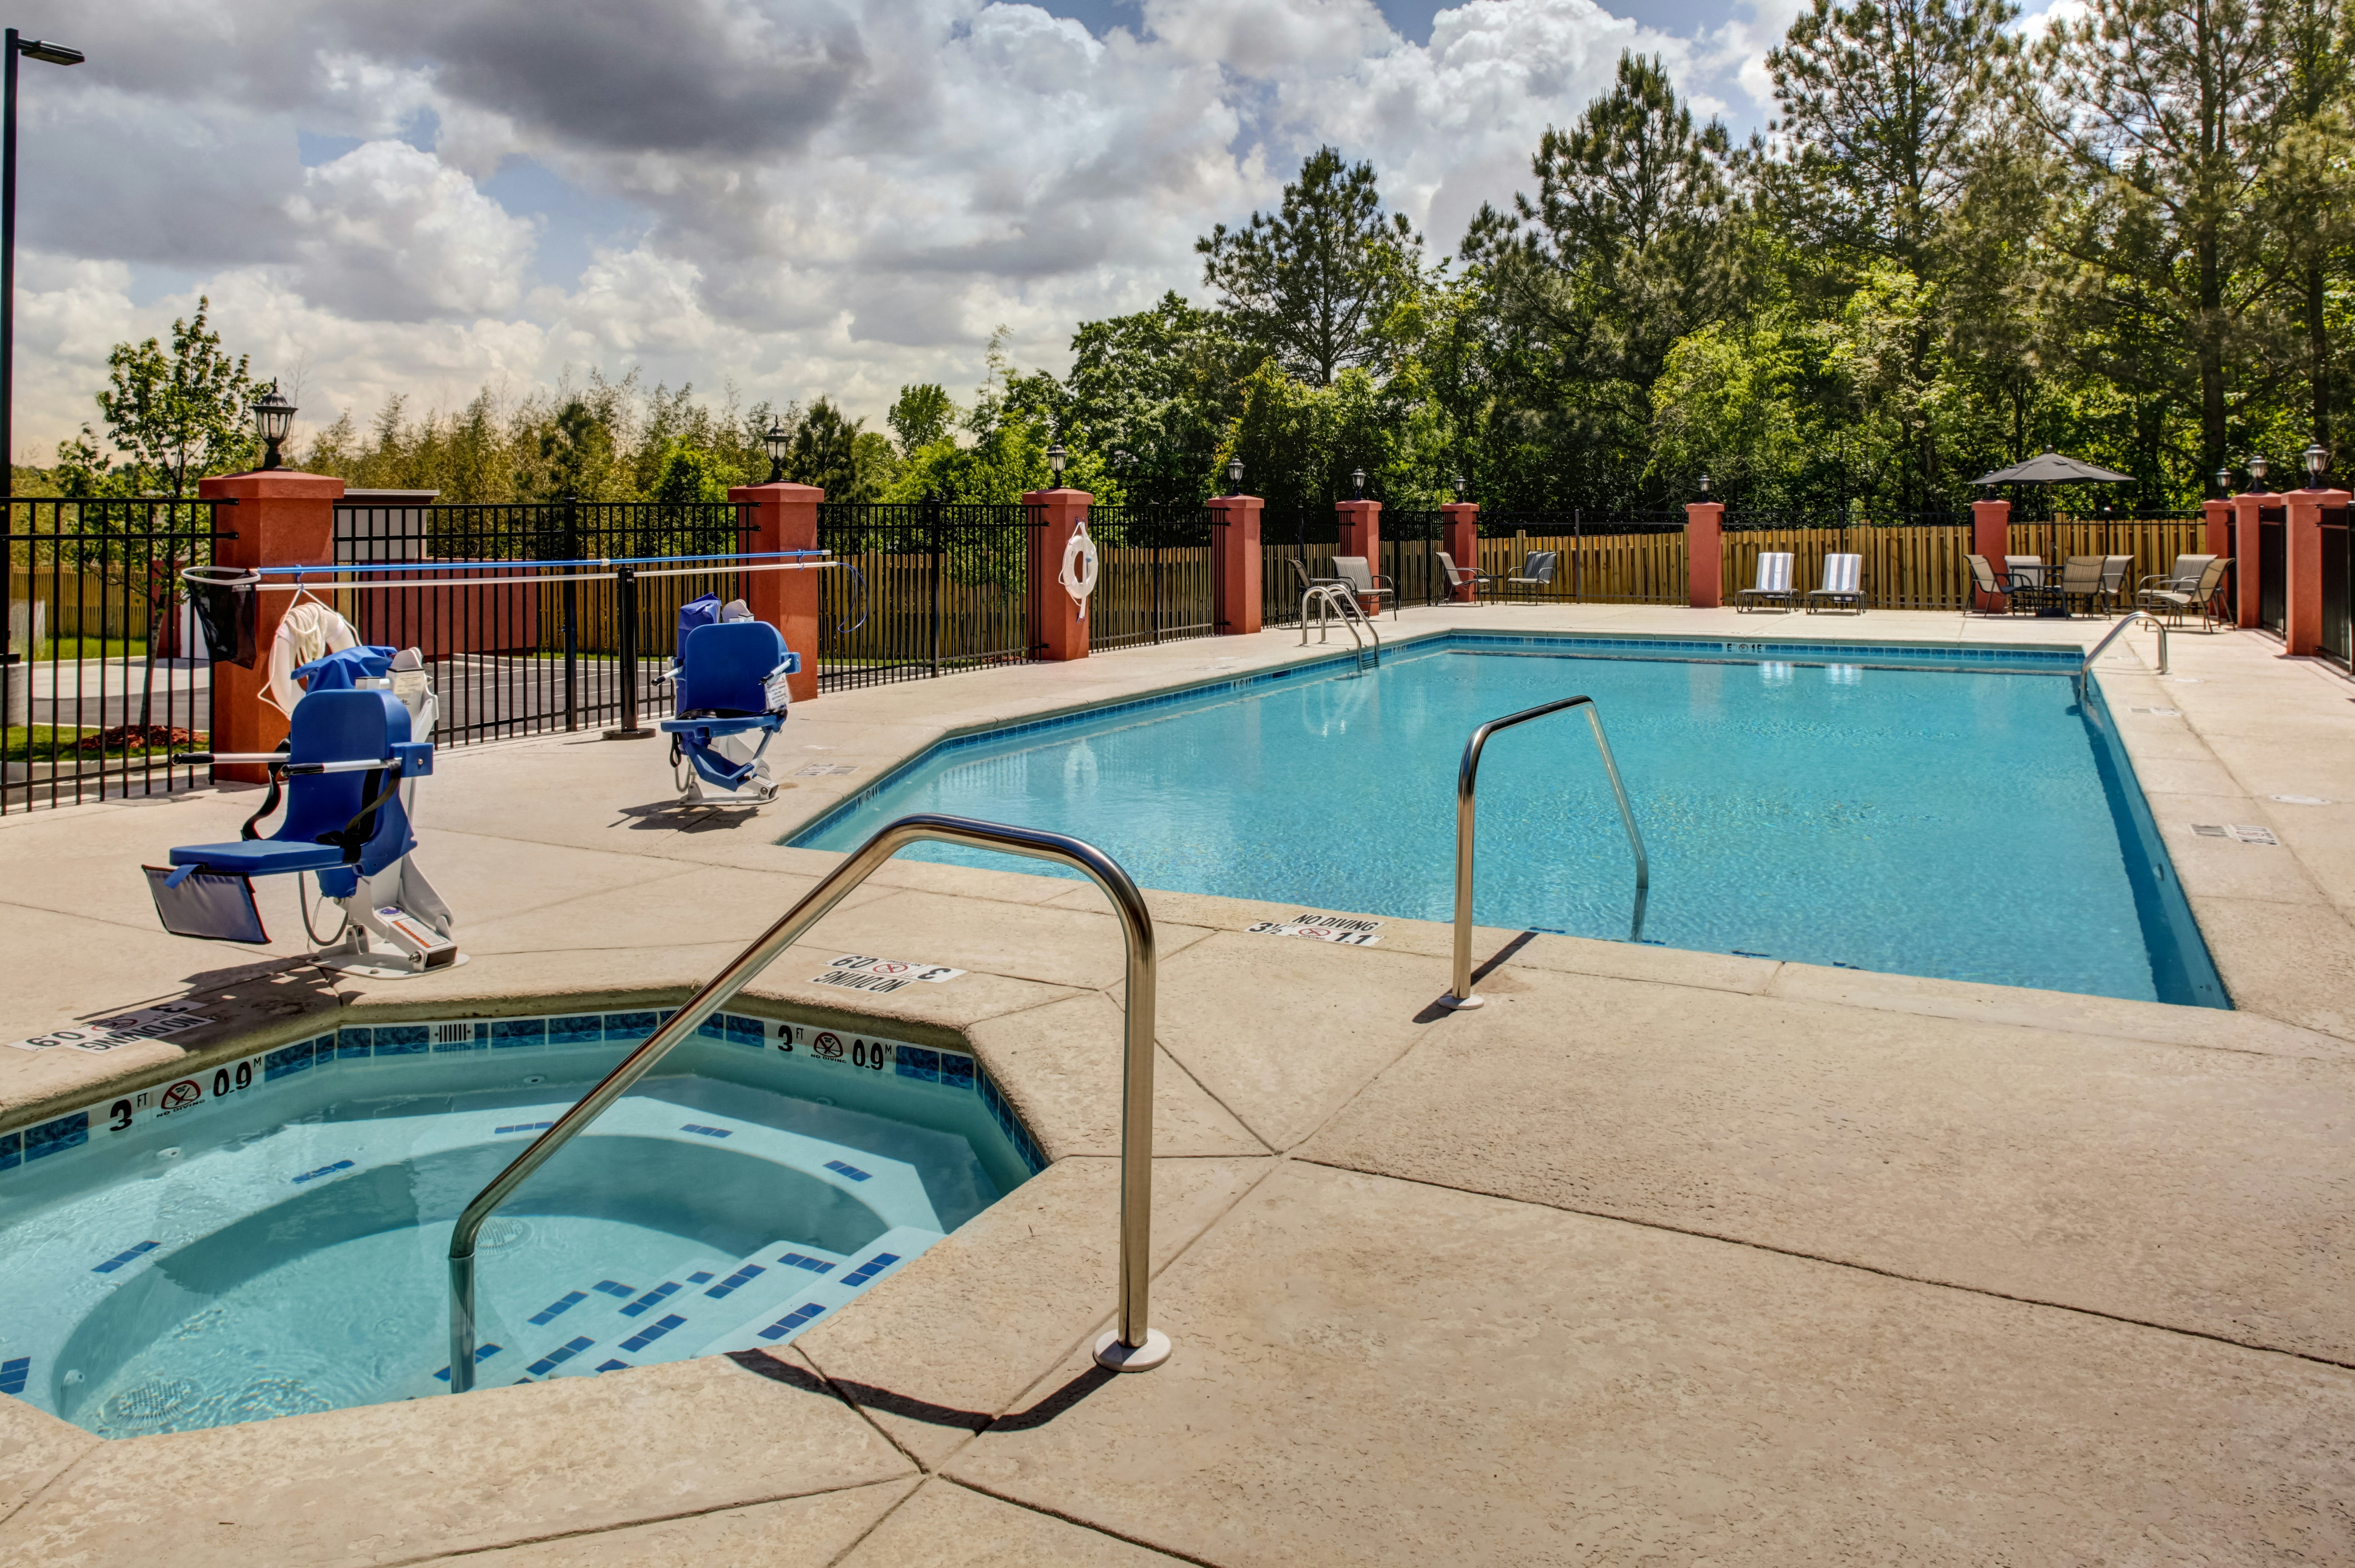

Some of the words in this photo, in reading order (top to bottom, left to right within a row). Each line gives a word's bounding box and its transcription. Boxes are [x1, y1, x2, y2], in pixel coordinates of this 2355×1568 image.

[1292, 914, 1322, 924] NO
[1317, 917, 1379, 931] DIVING
[1334, 932, 1372, 944] 1.1
[832, 956, 879, 969] 0.9
[813, 971, 884, 989] DIVING
[918, 968, 952, 979] 3
[868, 979, 911, 993] NO
[149, 1004, 188, 1013] 3
[160, 1015, 205, 1028] NO
[26, 1031, 86, 1047] 0.9
[76, 1024, 166, 1051] DIVING
[777, 1025, 793, 1052] 3
[796, 1028, 804, 1040] FT
[853, 1039, 884, 1070] 0.9
[885, 1044, 892, 1055] M
[110, 1099, 133, 1132] 3
[137, 1092, 148, 1108] FT
[213, 1061, 252, 1097] 0.9
[253, 1057, 261, 1068] M
[173, 1099, 206, 1112] DIVING
